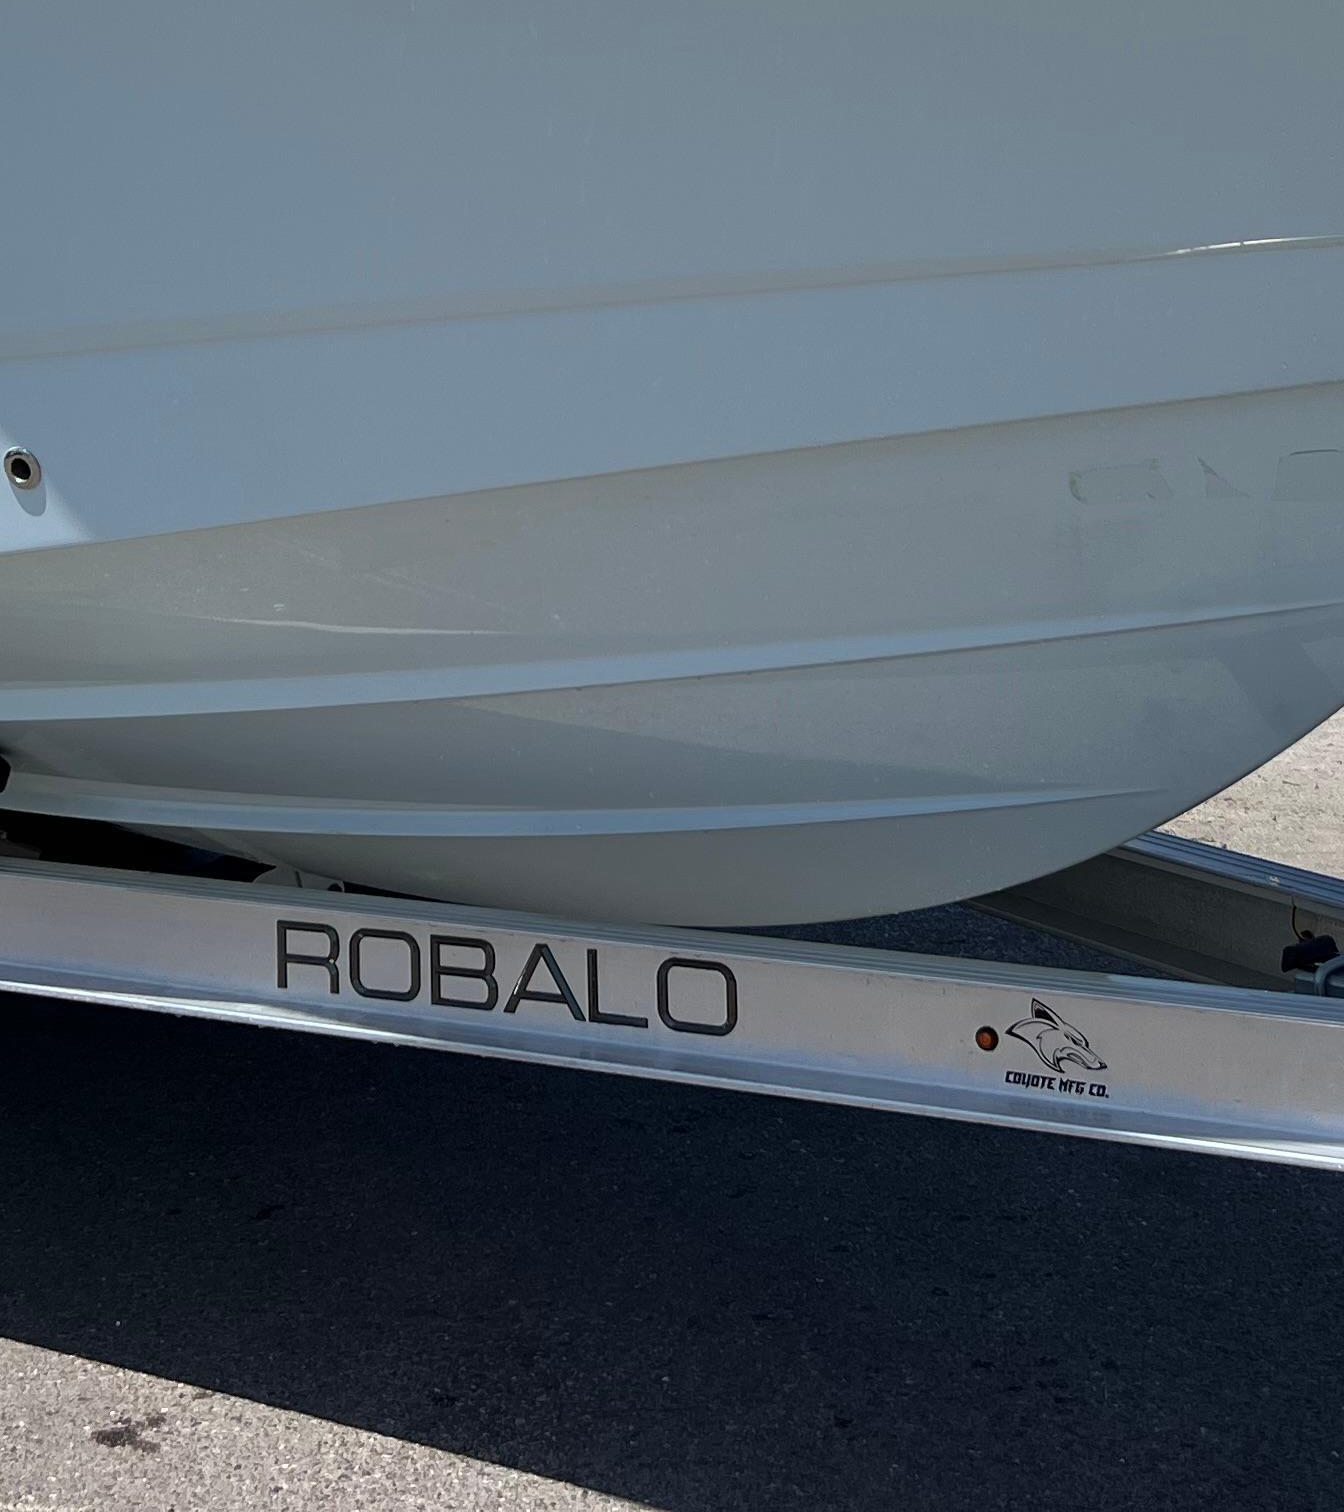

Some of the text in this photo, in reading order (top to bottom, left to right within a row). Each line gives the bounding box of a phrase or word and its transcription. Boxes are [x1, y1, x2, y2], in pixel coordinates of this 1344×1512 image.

[276, 920, 738, 1036] ROBALO
[1005, 1071, 1109, 1098] COYOTE MFG CO.
